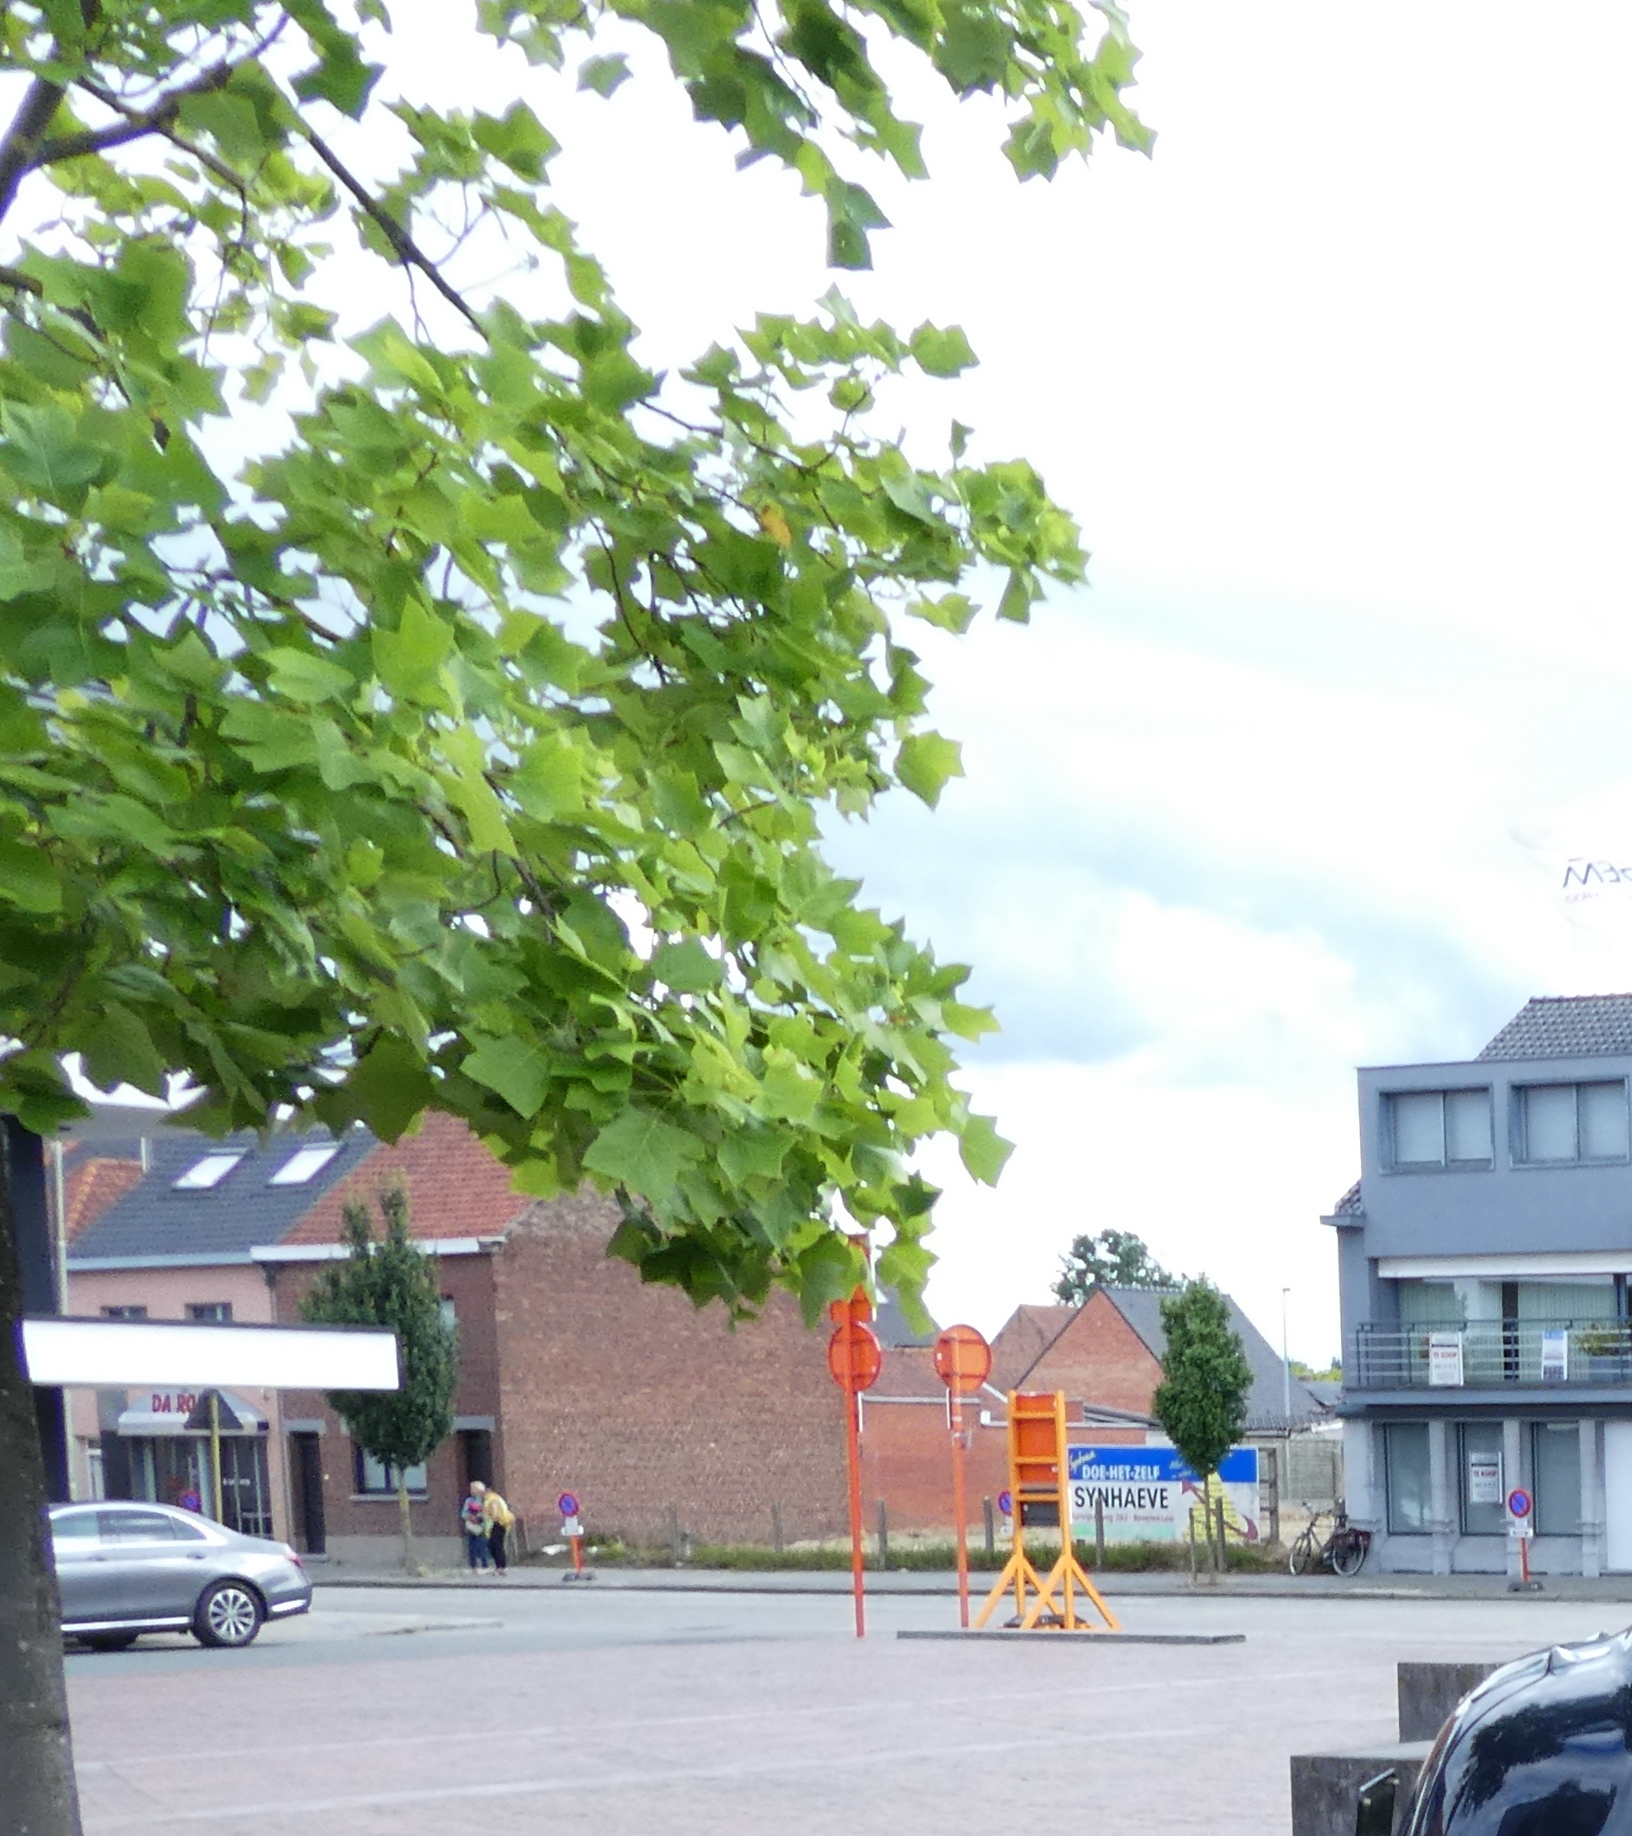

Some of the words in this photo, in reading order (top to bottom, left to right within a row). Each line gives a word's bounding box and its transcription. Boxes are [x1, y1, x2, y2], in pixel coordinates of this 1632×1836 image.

[152, 1394, 171, 1413] DA
[176, 1393, 197, 1414] RO
[1081, 1464, 1160, 1480] DOE-HET-ZELF
[1074, 1486, 1169, 1509] SYNHAEVE
